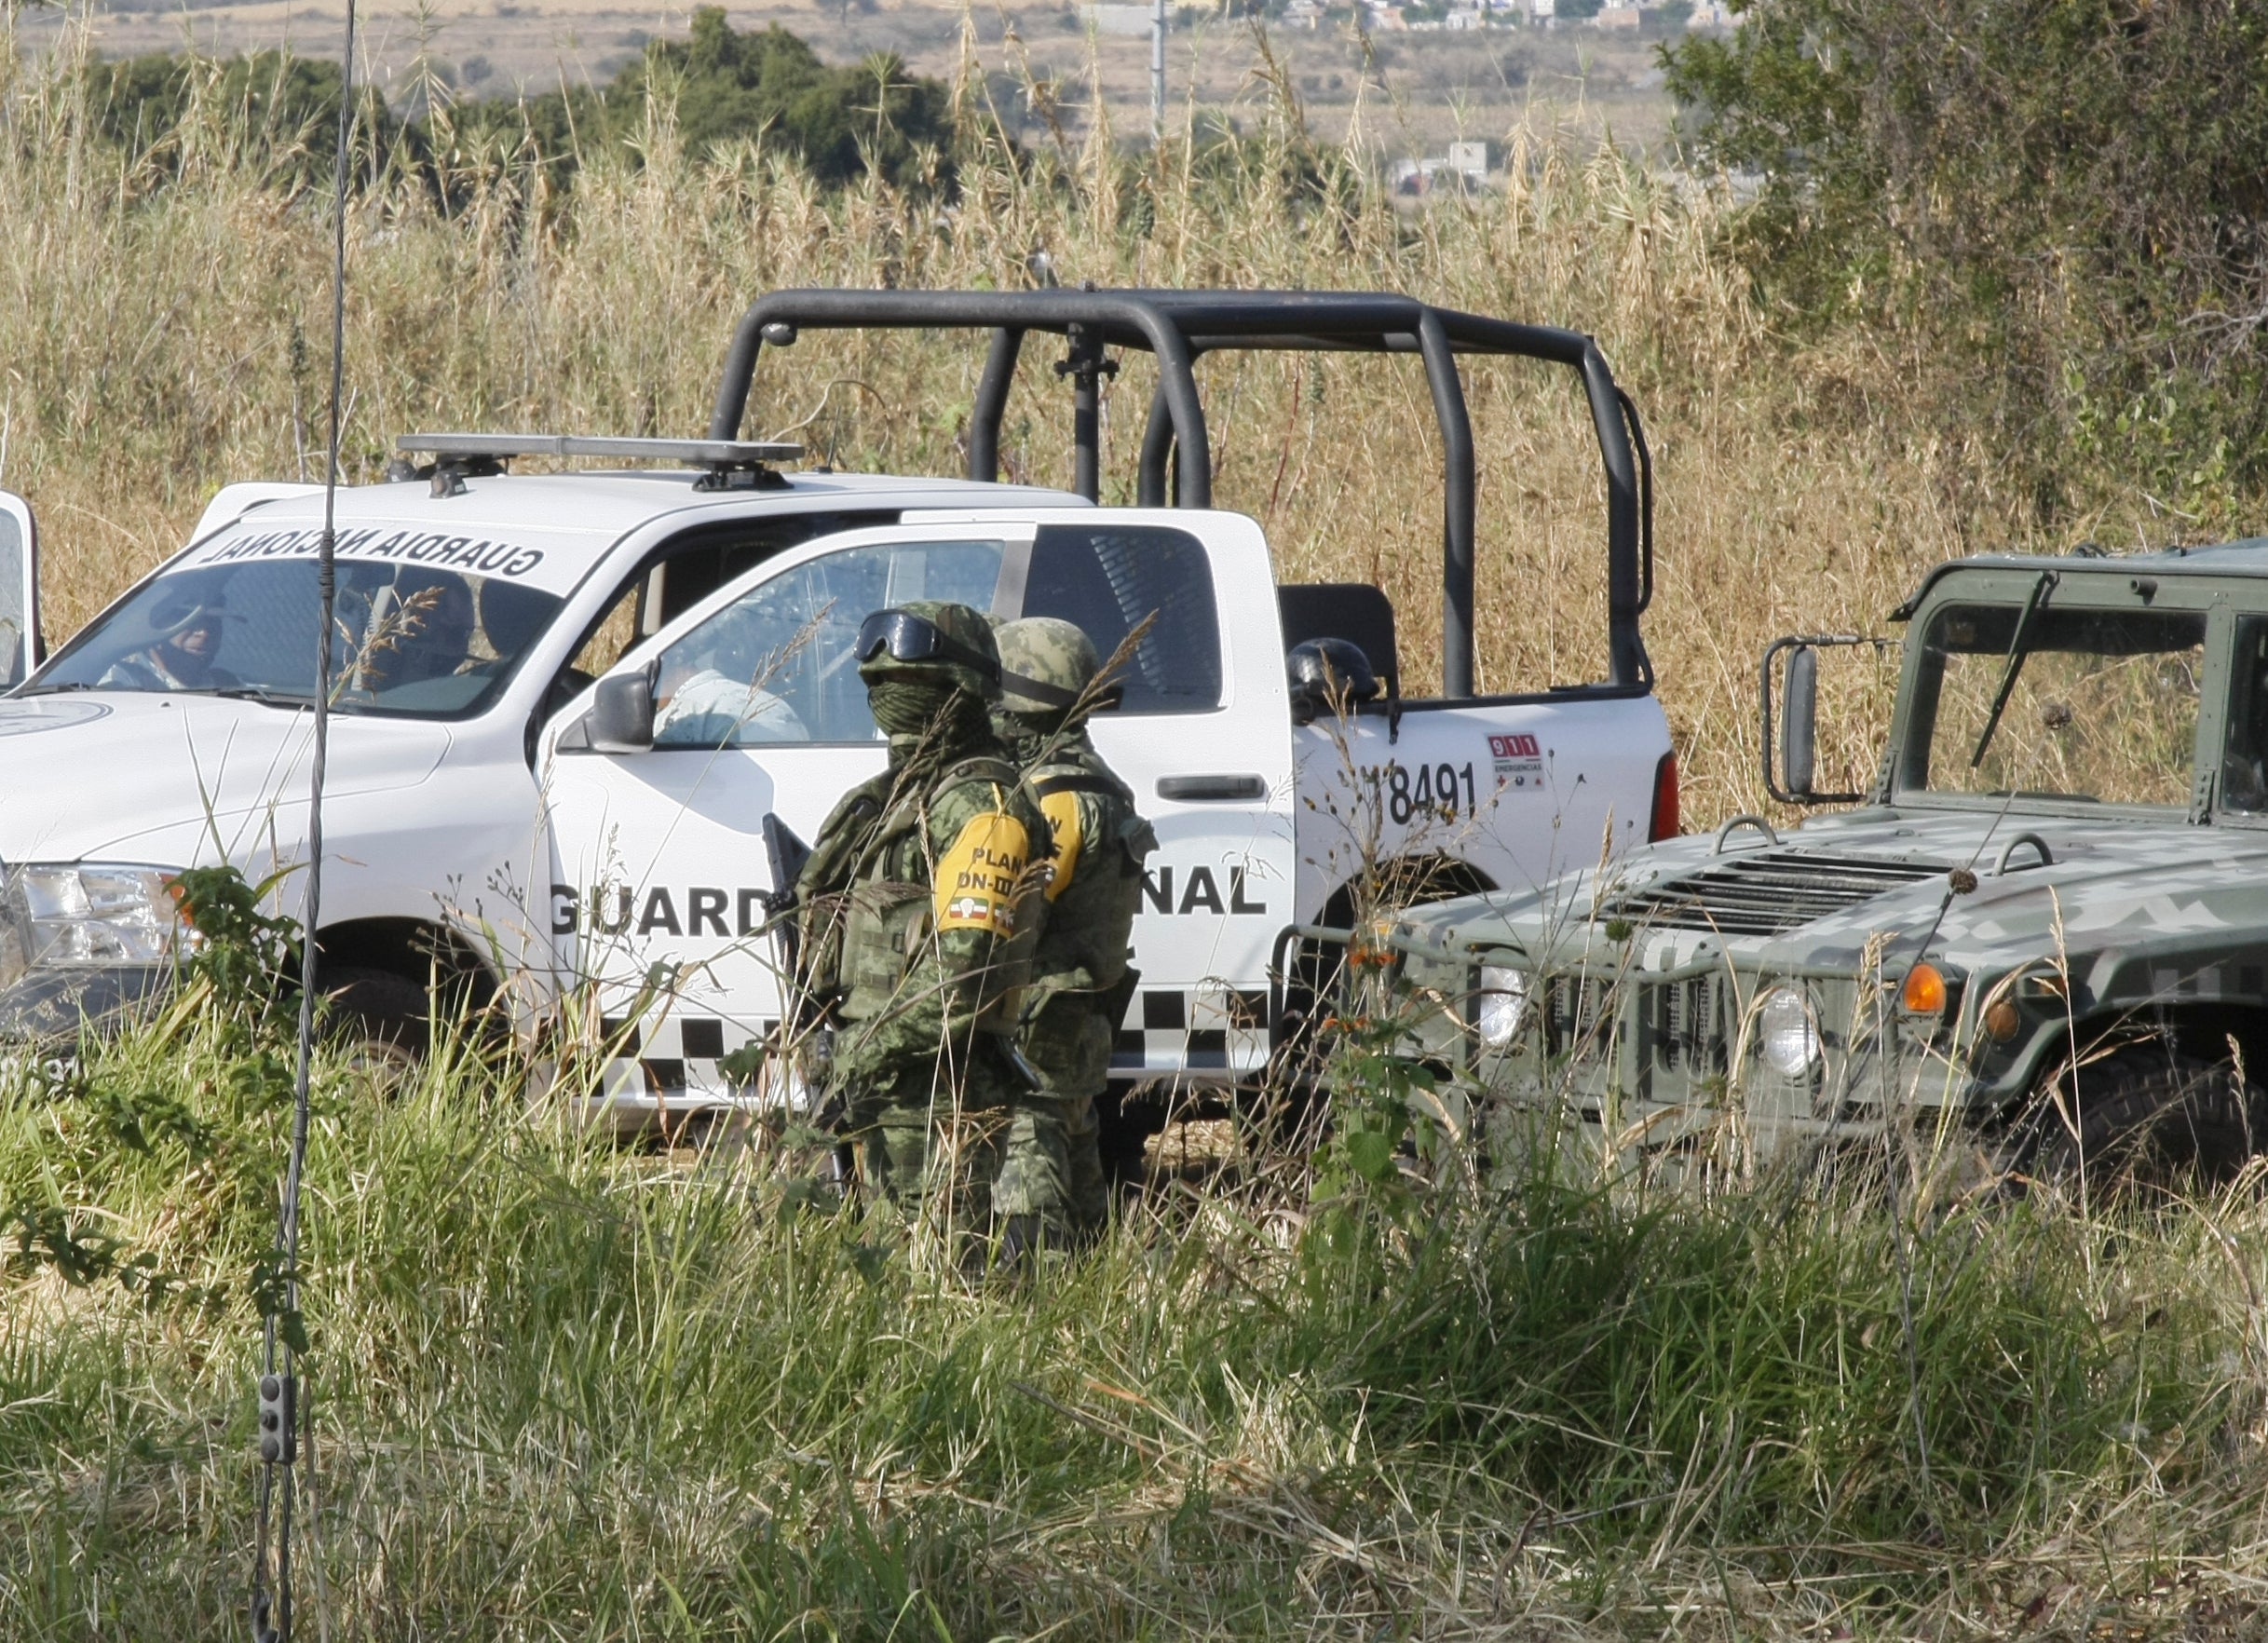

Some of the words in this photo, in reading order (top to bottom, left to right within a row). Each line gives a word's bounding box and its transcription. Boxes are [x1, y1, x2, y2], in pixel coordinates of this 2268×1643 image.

[1492, 737, 1535, 755] 911
[1494, 764, 1541, 773] EMERGENCIAS
[971, 848, 1023, 876] PLAN
[957, 871, 1013, 897] DN-III
[550, 884, 775, 937] GUARD
[1134, 865, 1267, 915] NAL
